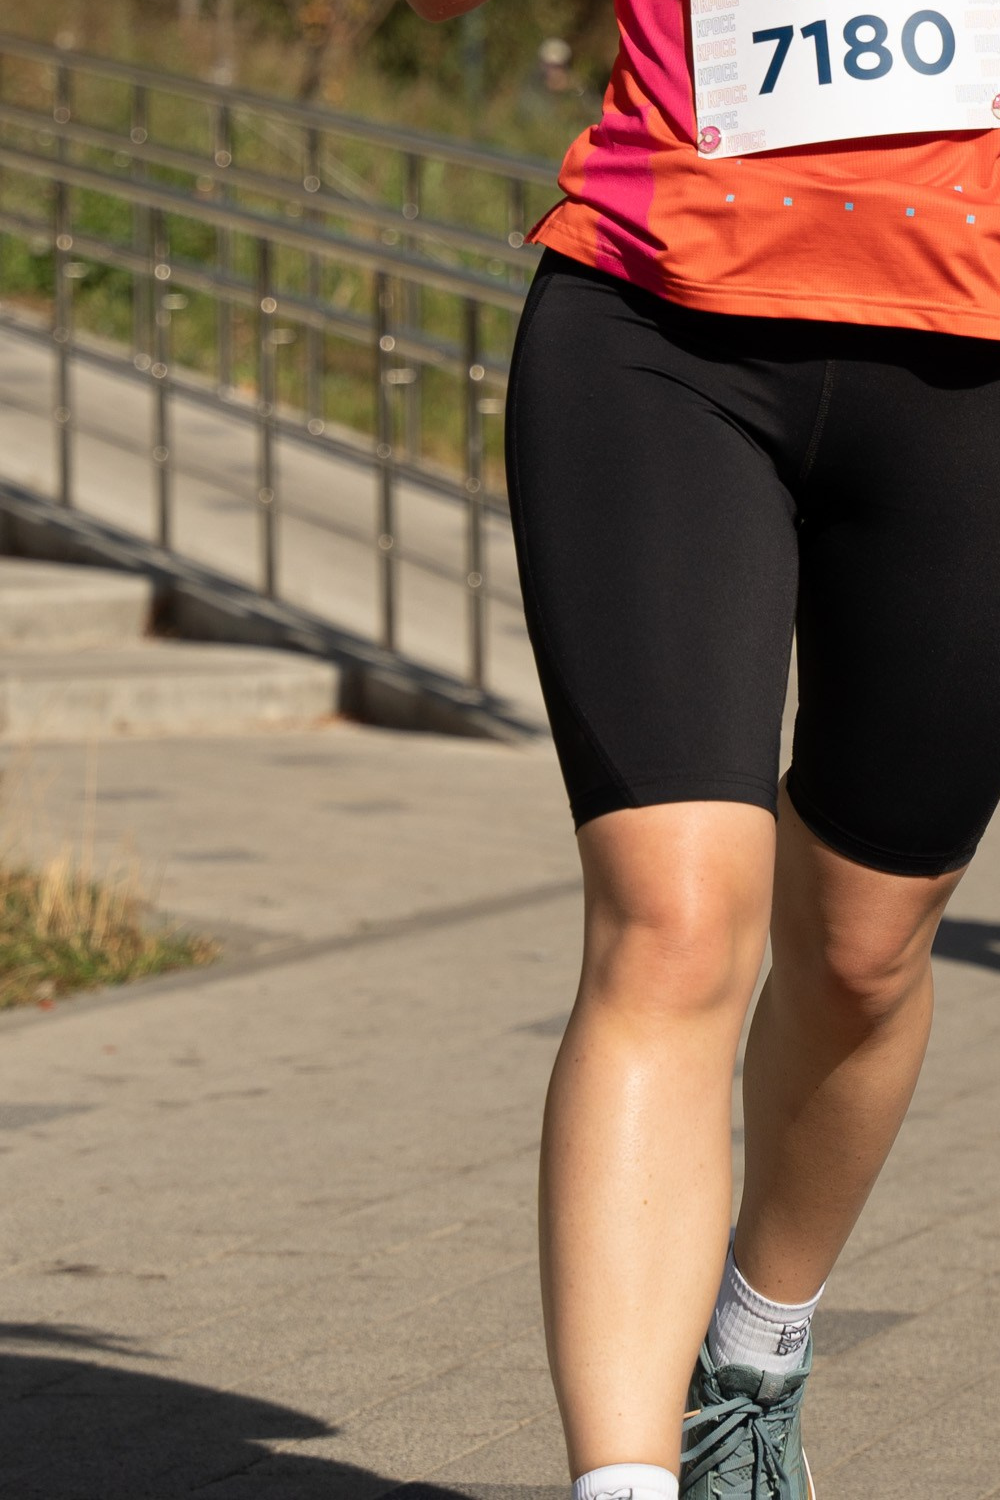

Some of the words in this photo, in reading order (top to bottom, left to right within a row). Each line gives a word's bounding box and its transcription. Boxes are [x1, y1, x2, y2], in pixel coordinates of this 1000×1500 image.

[696, 13, 736, 38] КРОСС
[697, 38, 737, 62] КРОСС
[752, 9, 956, 95] 7180
[698, 62, 739, 86] КРОСС
